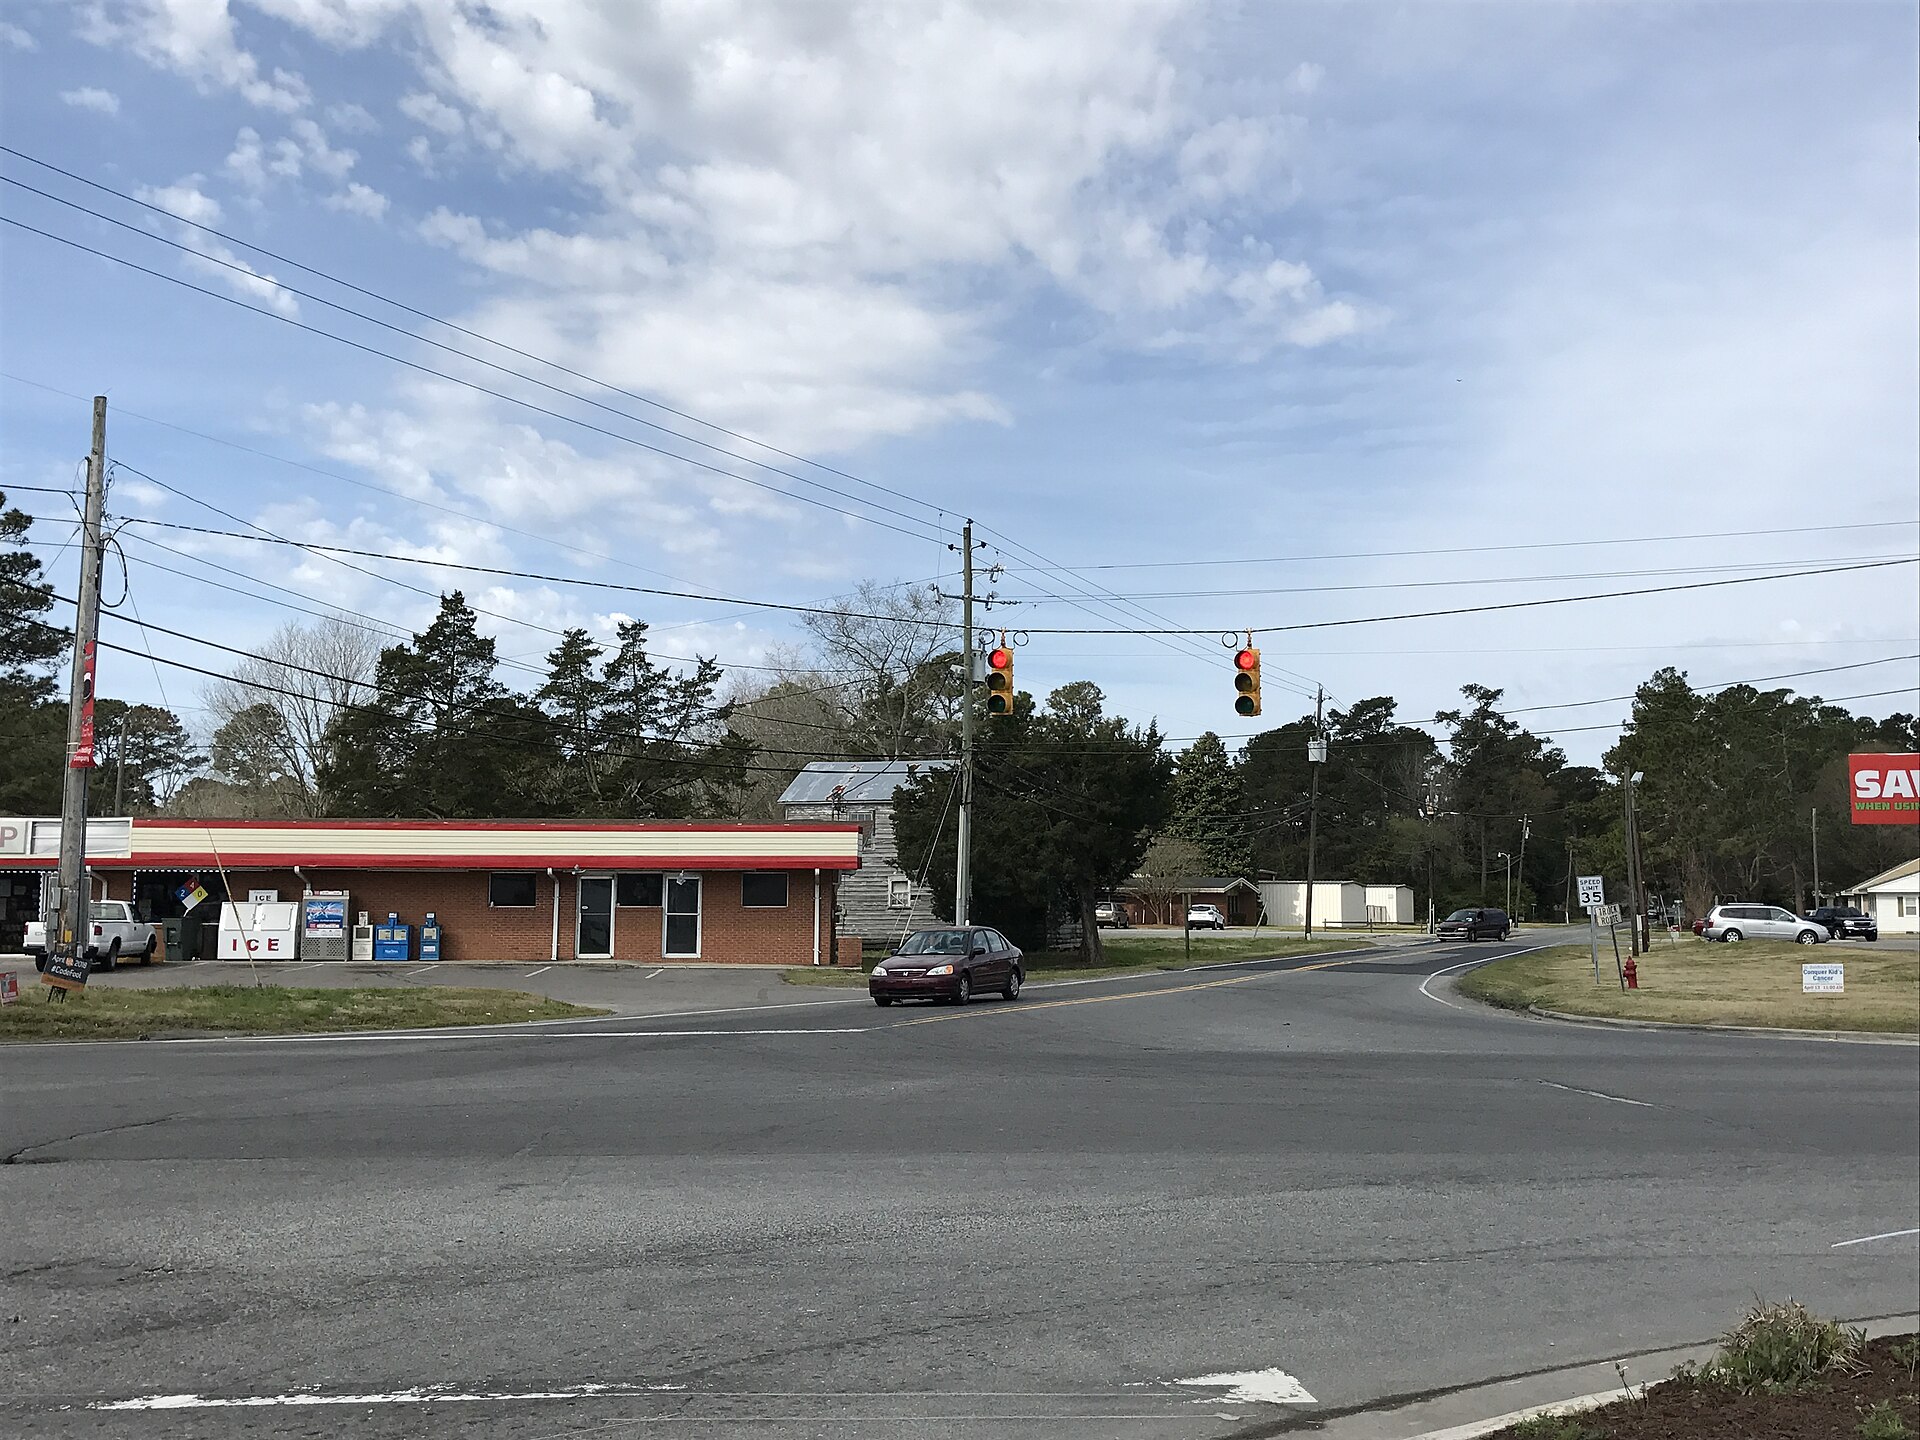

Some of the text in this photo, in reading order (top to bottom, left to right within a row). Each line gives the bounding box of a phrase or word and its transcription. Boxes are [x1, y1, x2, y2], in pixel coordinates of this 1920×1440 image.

[1855, 802, 1890, 811] WHEN
[1581, 892, 1602, 903] 35
[1598, 906, 1618, 916] TRUCK
[1601, 914, 1618, 924] ROUTE
[232, 937, 280, 952] ICE
